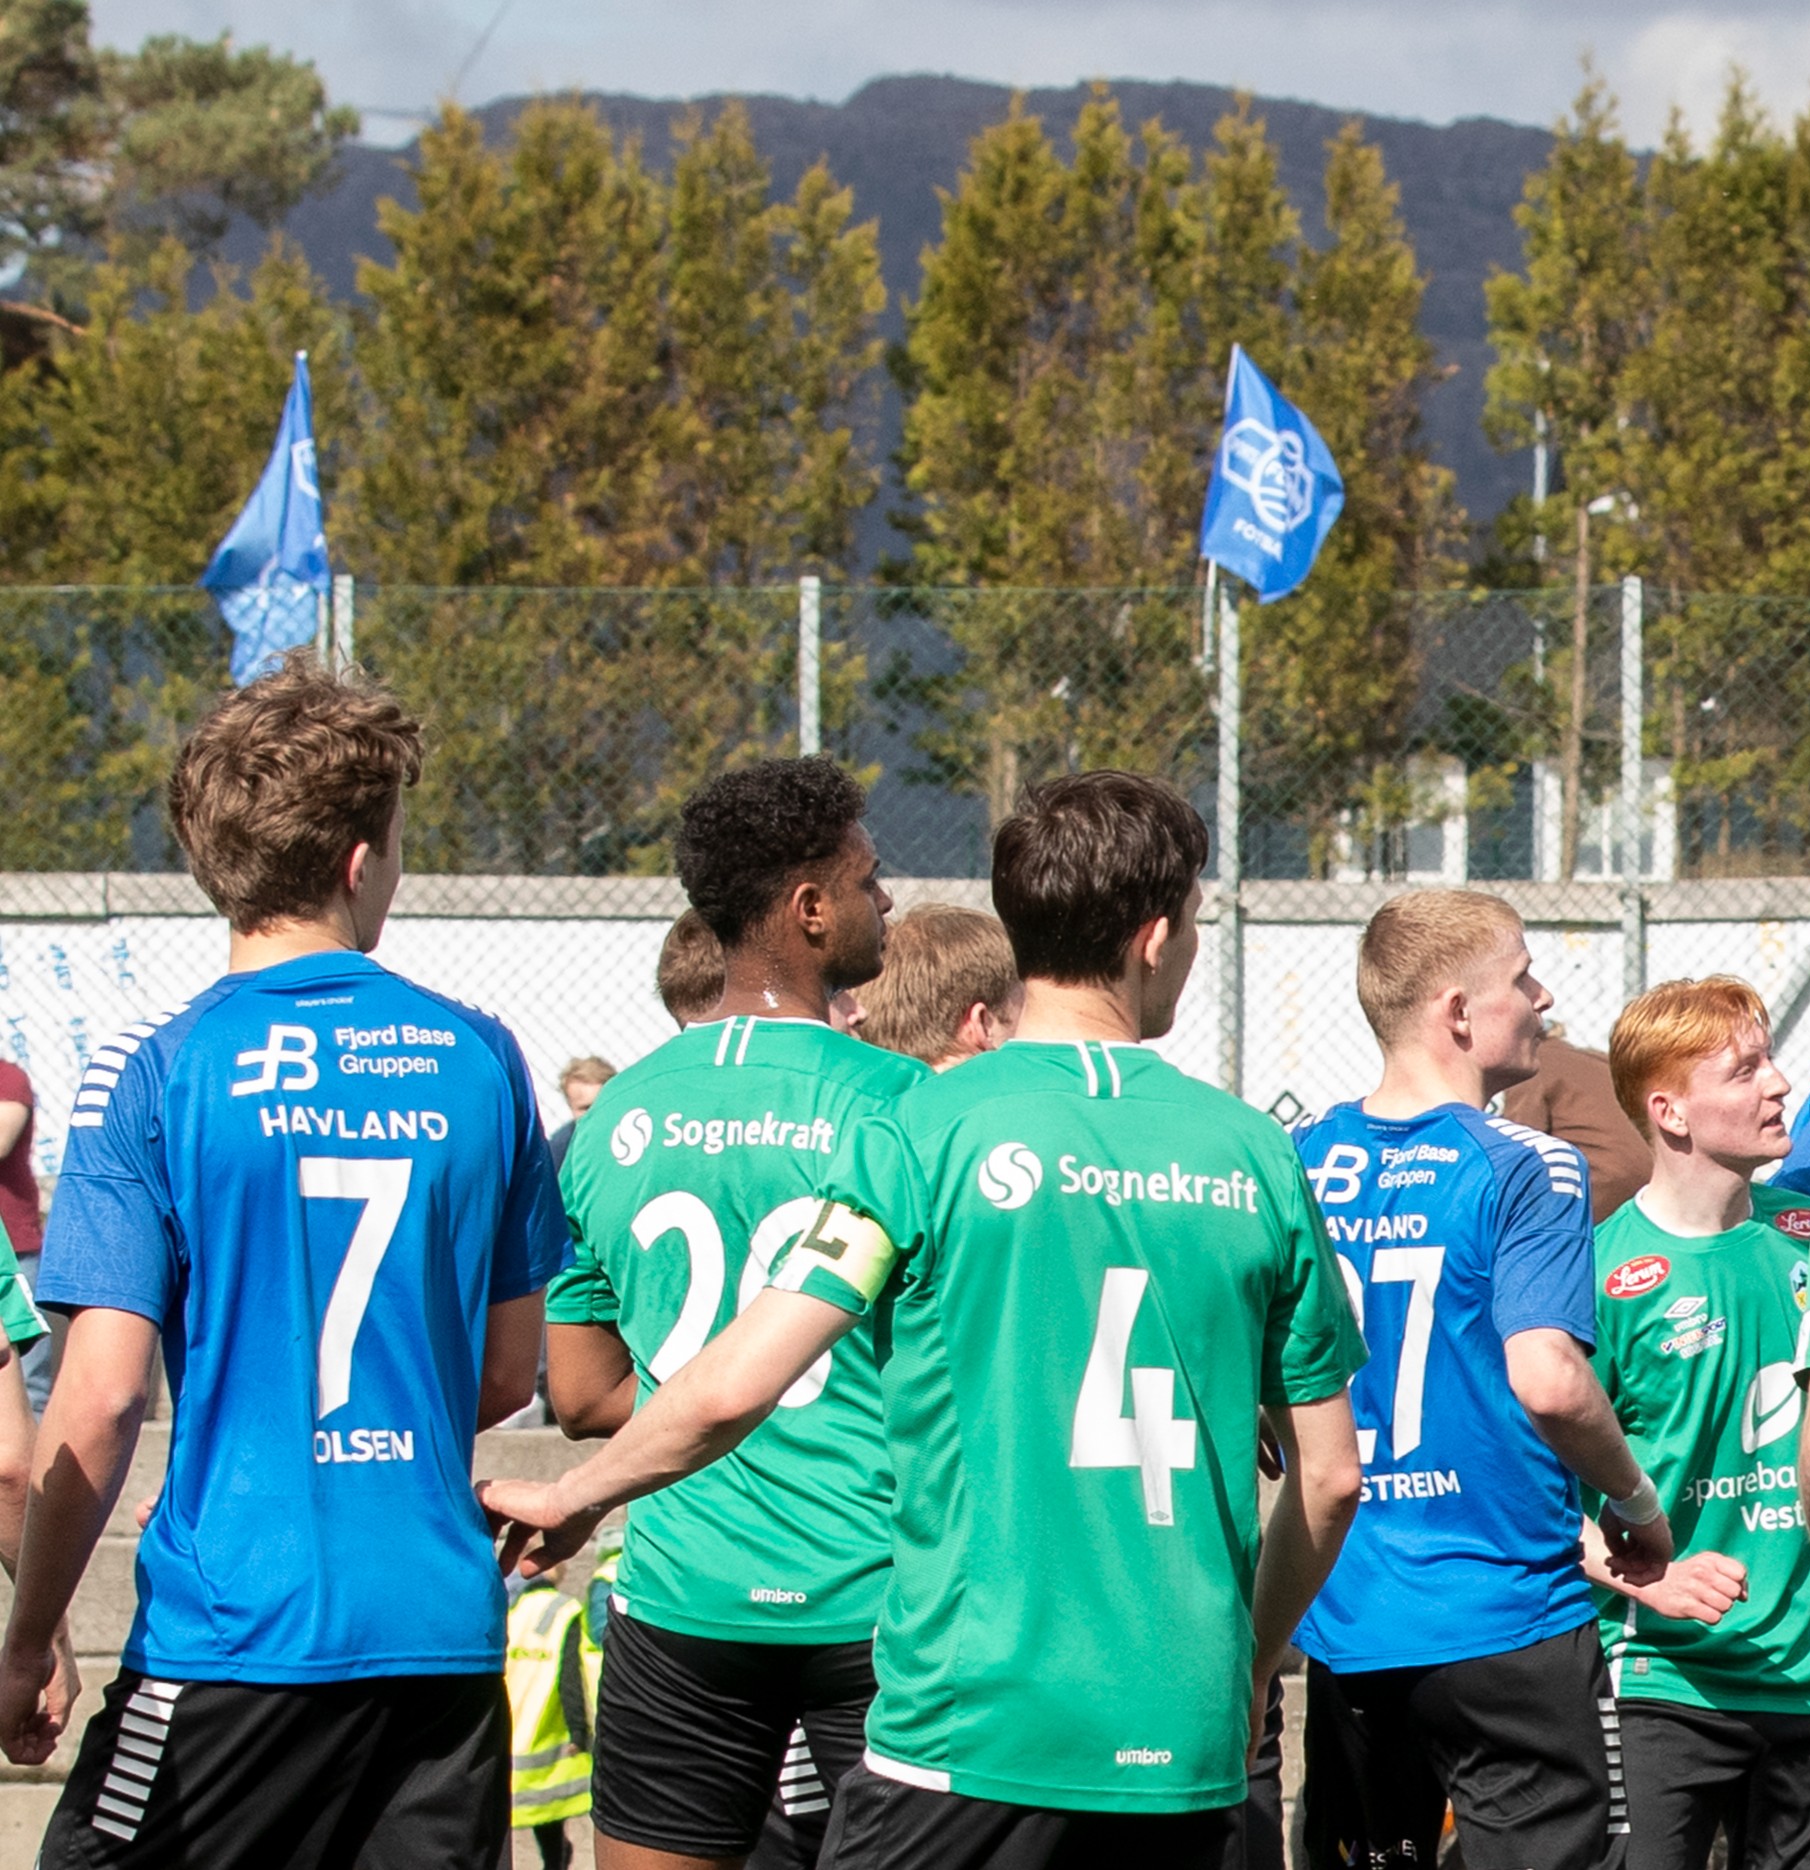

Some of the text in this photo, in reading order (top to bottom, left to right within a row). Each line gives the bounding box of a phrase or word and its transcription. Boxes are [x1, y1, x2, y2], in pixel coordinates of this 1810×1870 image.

[335, 1024, 457, 1050] Fjord Base
[338, 1053, 439, 1078] Gruppen
[259, 1103, 449, 1141] HAVLAND
[662, 1111, 835, 1155] Sognekraft
[1417, 1143, 1460, 1164] Base
[1058, 1154, 1258, 1214] Sognekraft
[1325, 1213, 1429, 1244] AVLAND
[299, 1157, 414, 1420] 7
[1069, 1266, 1197, 1526] 4
[314, 1429, 415, 1464] OLSEN
[1359, 1469, 1462, 1503] STREIM
[1682, 1460, 1798, 1508] Spareba
[750, 1587, 807, 1604] umbro
[1115, 1747, 1172, 1766] umbro
